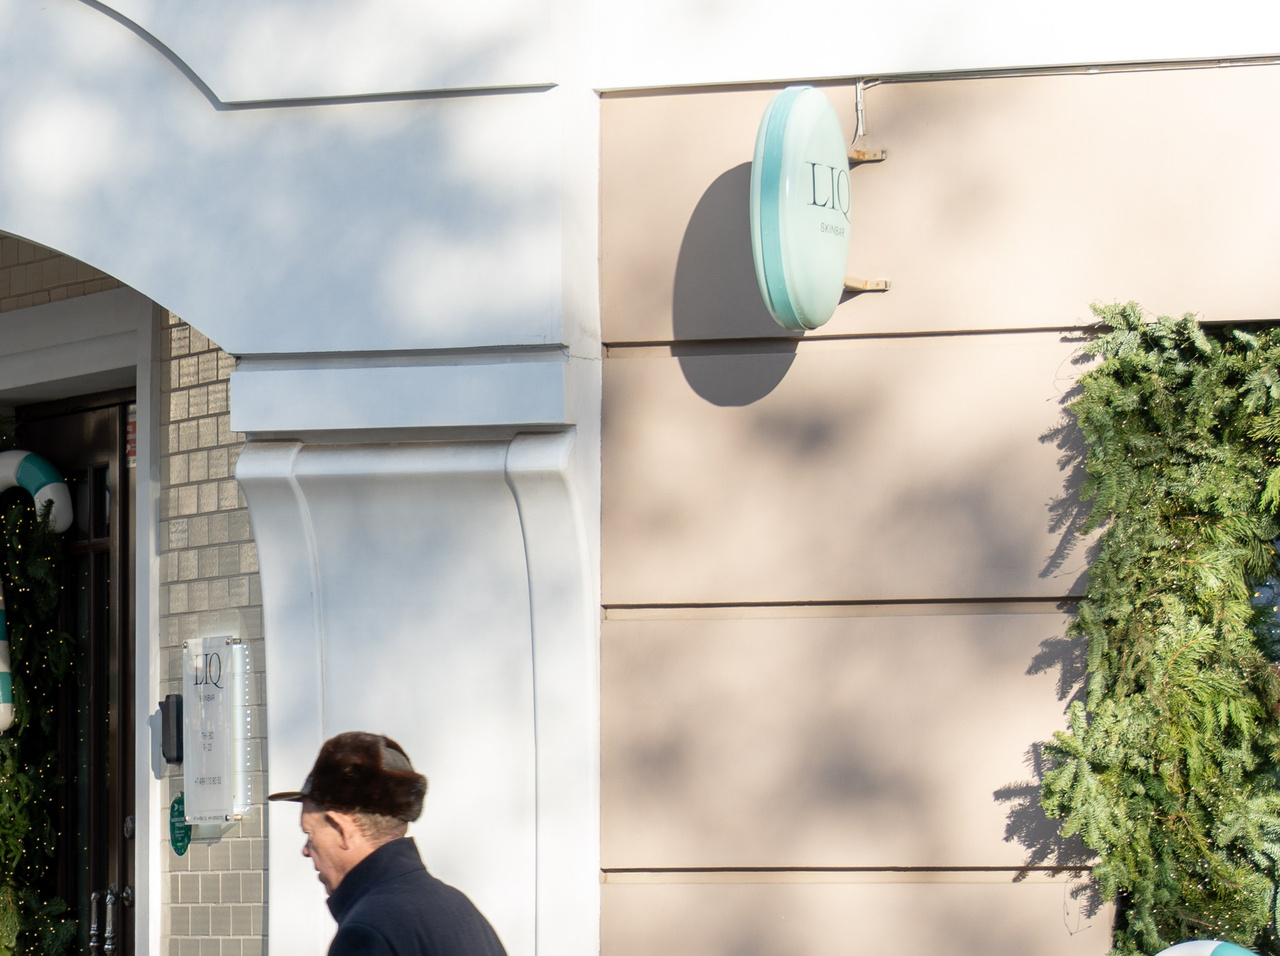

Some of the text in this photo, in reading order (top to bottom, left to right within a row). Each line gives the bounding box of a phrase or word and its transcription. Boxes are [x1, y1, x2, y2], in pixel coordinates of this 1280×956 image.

[805, 161, 852, 224] LIQ
[819, 222, 845, 237] SKINBAR
[193, 652, 224, 689] LIQ
